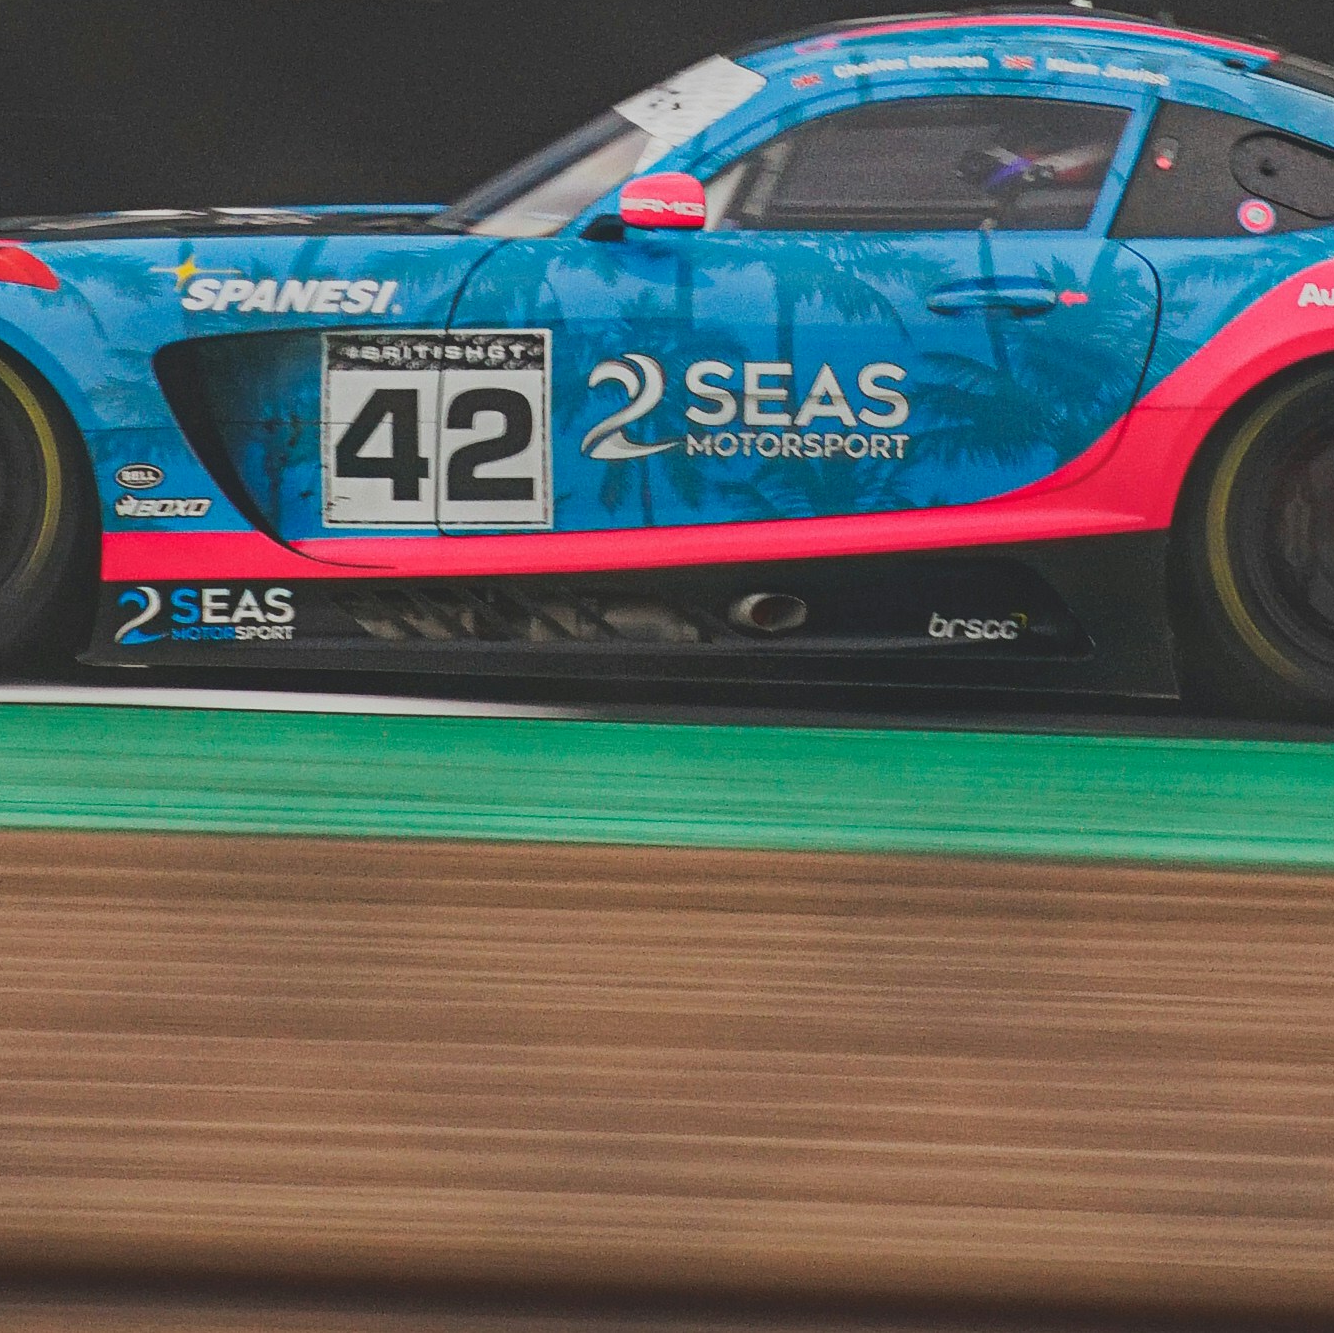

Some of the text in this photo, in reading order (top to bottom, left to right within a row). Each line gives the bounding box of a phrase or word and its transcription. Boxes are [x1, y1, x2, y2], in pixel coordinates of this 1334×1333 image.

[581, 353, 910, 459] 2 SEAS
[335, 387, 534, 501] 42
[685, 432, 910, 459] MOTORSPORT
[170, 587, 295, 624] SEAS
[171, 625, 296, 640] MOTORSPORT
[928, 612, 1018, 640] brscc
